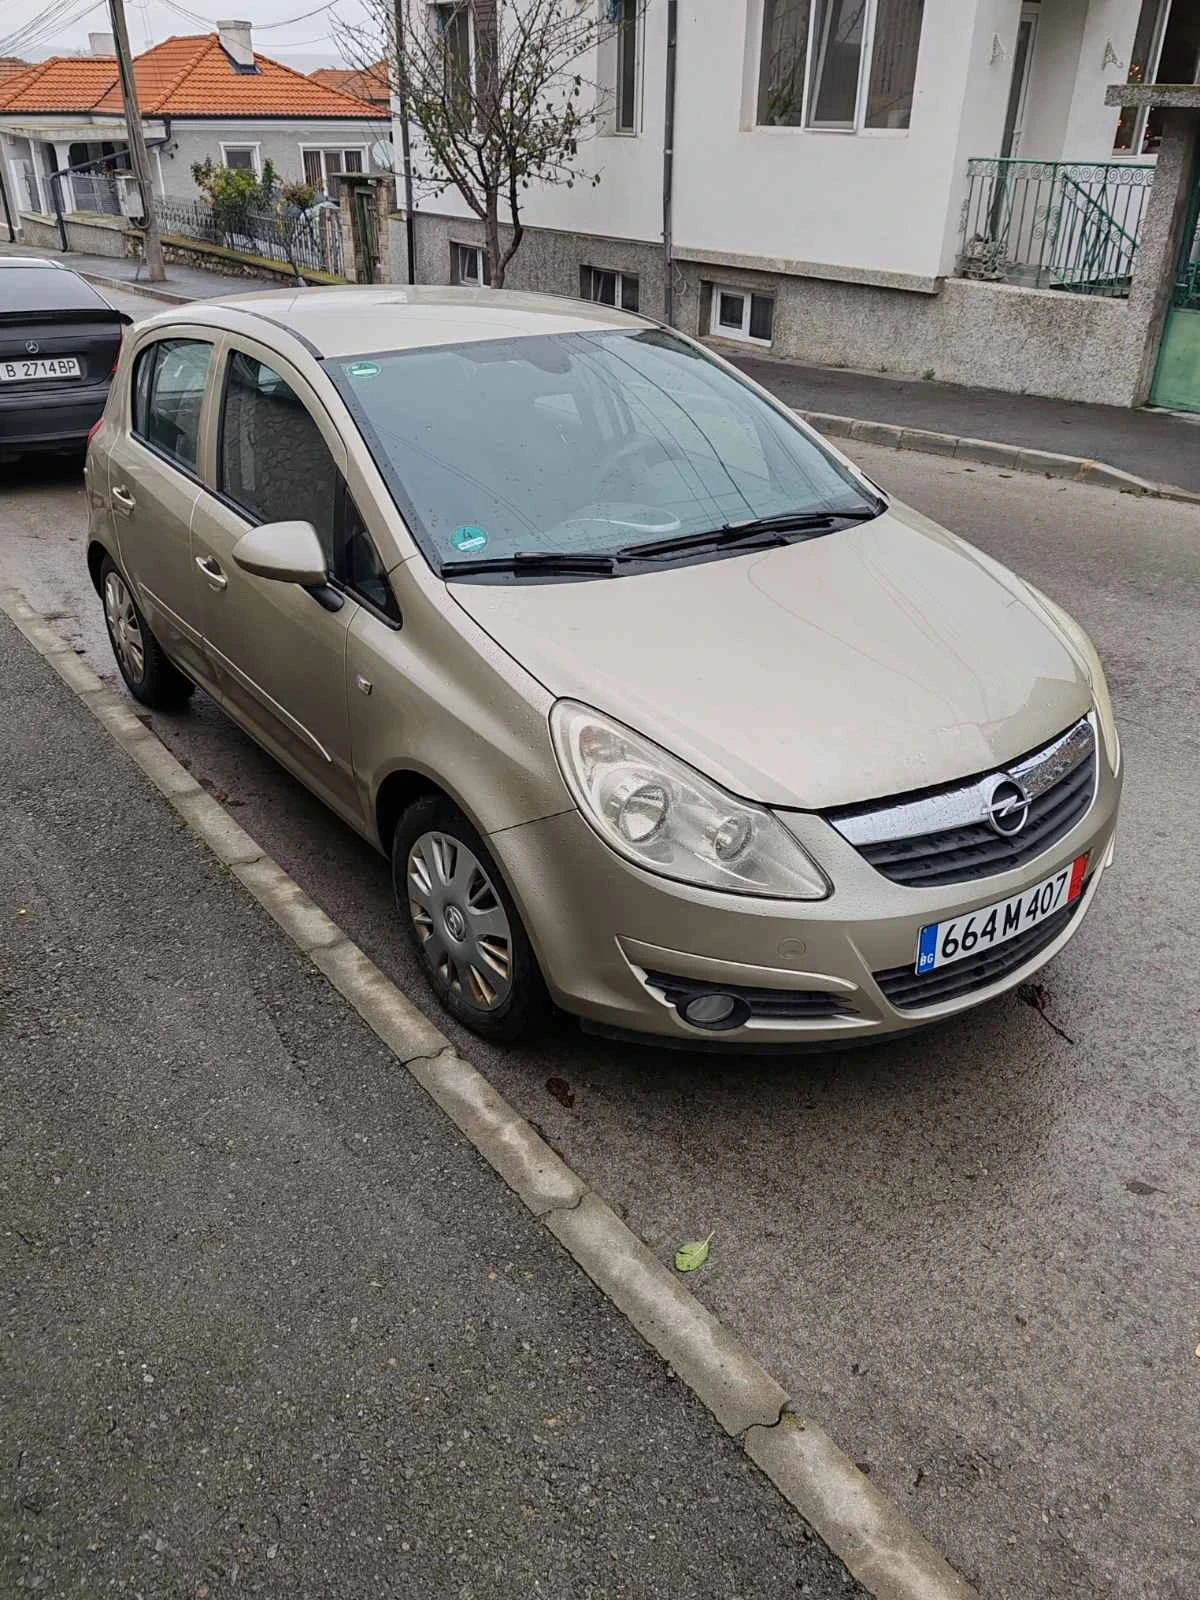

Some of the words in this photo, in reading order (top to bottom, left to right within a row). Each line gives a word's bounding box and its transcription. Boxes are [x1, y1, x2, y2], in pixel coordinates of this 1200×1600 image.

[5, 364, 16, 378] B
[941, 909, 997, 958] 664
[1002, 898, 1023, 937] M
[1025, 871, 1068, 921] 407
[920, 953, 934, 966] BG
